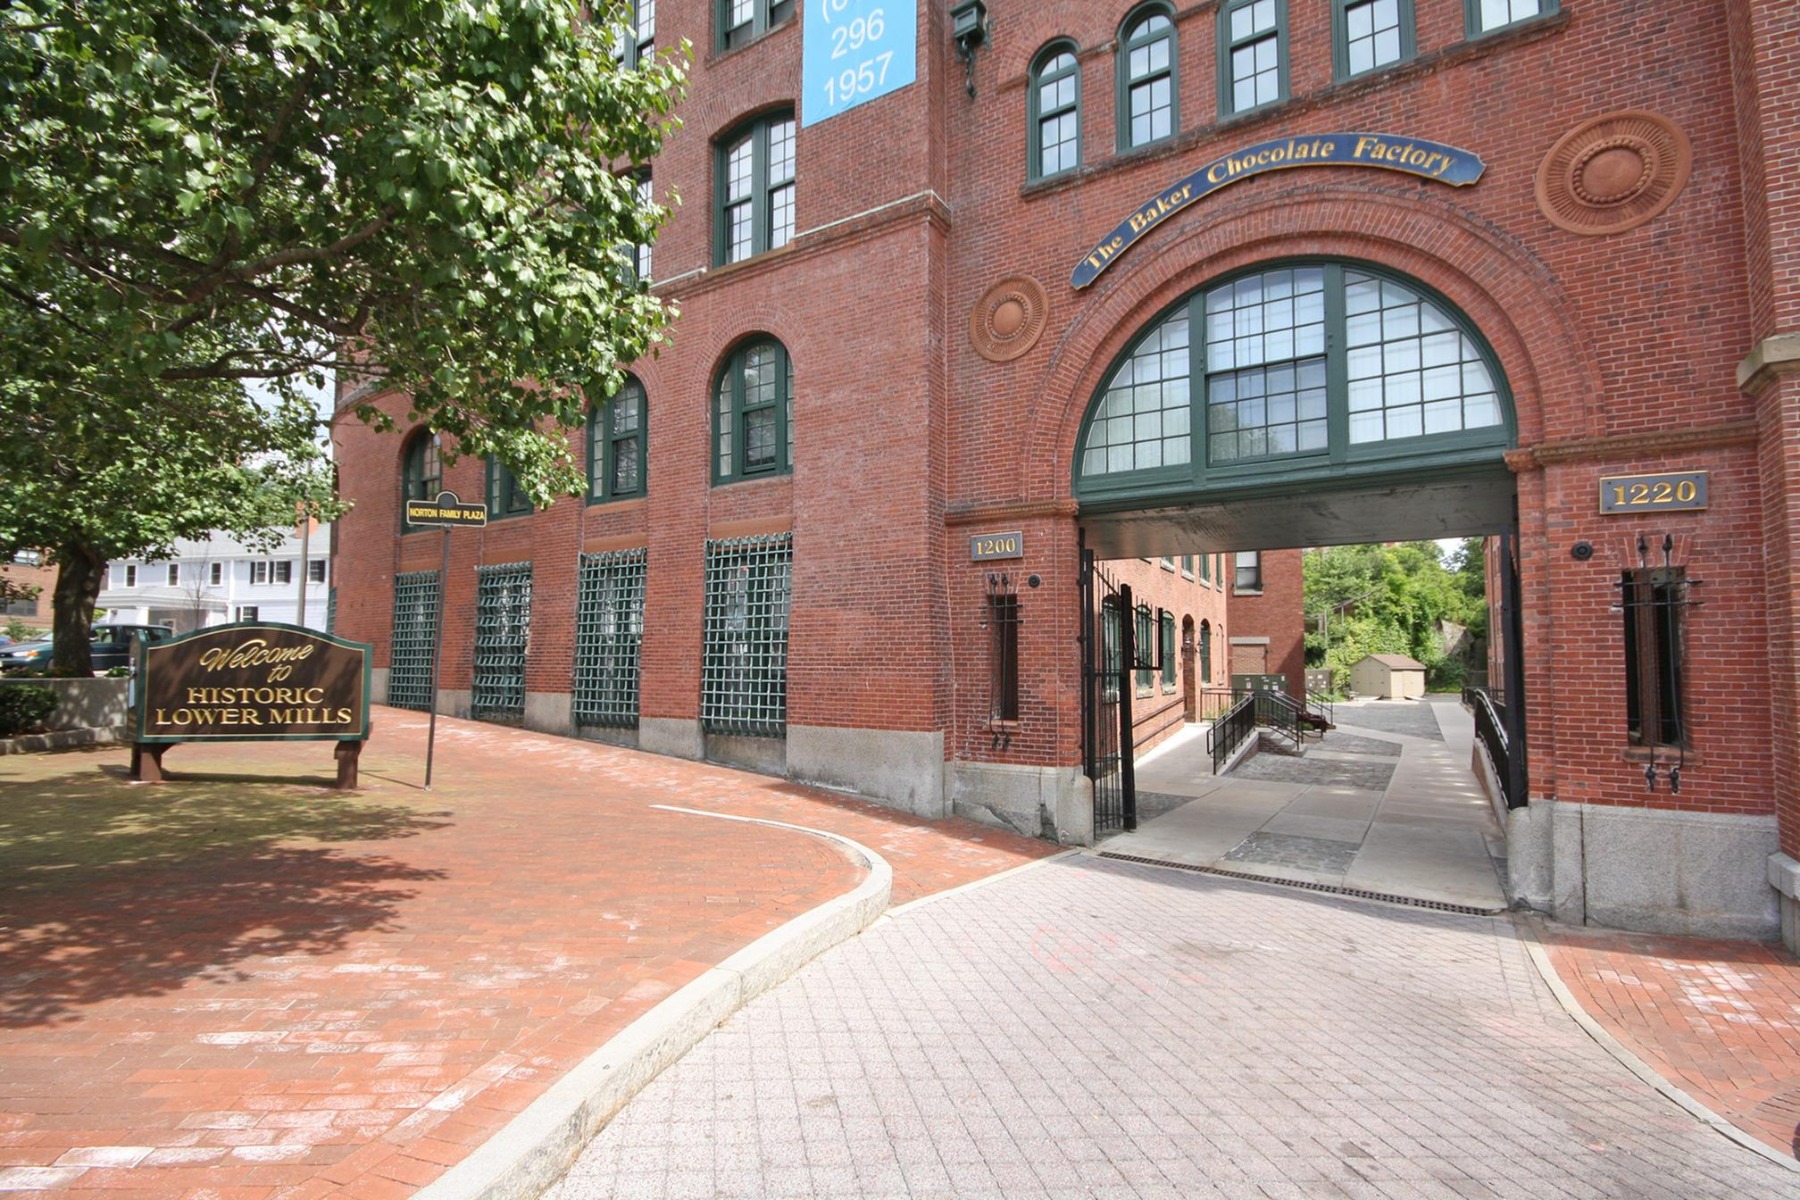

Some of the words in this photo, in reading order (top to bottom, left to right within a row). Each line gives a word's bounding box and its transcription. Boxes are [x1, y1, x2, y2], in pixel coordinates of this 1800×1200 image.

[831, 8, 884, 60] 296
[824, 50, 894, 107] 1957
[1084, 235, 1124, 271] The
[1128, 182, 1193, 234] Baker
[1206, 139, 1335, 185] Chocolate
[1352, 136, 1459, 177] Factory
[1613, 480, 1697, 506] 1220
[409, 507, 438, 518] NORTON
[439, 509, 462, 519] FAMILY
[463, 510, 485, 520] PLAZA
[976, 538, 1016, 555] 1200
[199, 638, 315, 673] Welcome
[266, 664, 292, 684] to
[186, 687, 324, 705] HISTORIC
[155, 707, 264, 726] LOWER
[269, 707, 353, 725] MILLS
